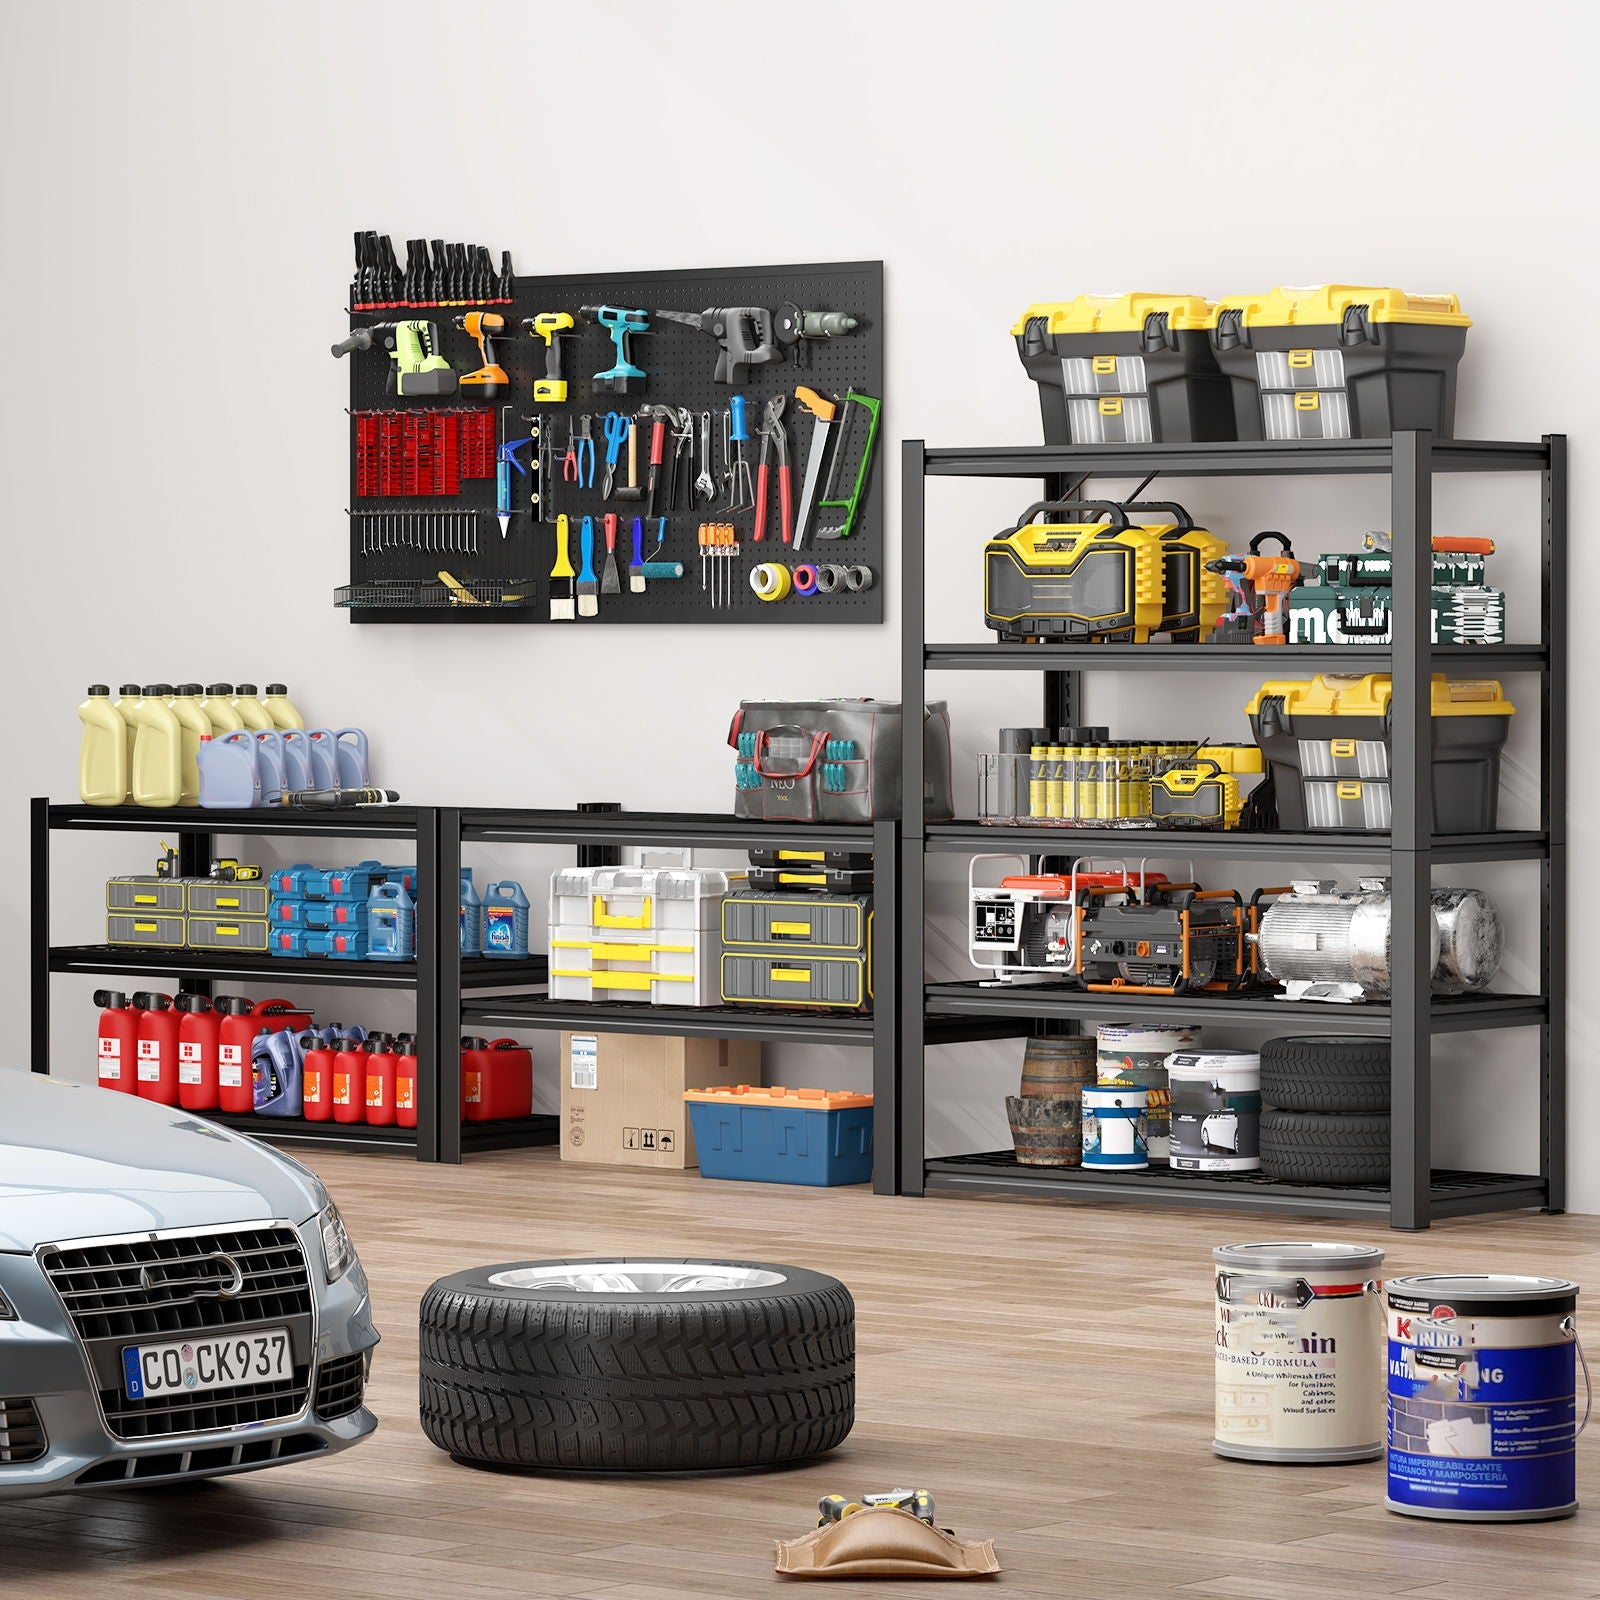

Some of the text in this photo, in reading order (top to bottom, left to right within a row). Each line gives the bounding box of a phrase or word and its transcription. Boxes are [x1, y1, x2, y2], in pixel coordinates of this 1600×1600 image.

[1261, 1358, 1318, 1368] FORMULA
[142, 1349, 182, 1390] CO
[1251, 1371, 1275, 1379] Unique
[131, 1380, 139, 1392] D
[1408, 1456, 1503, 1472] IMPERMEABILIZANTE
[1435, 1470, 1508, 1482] MAMPOSTERÍA
